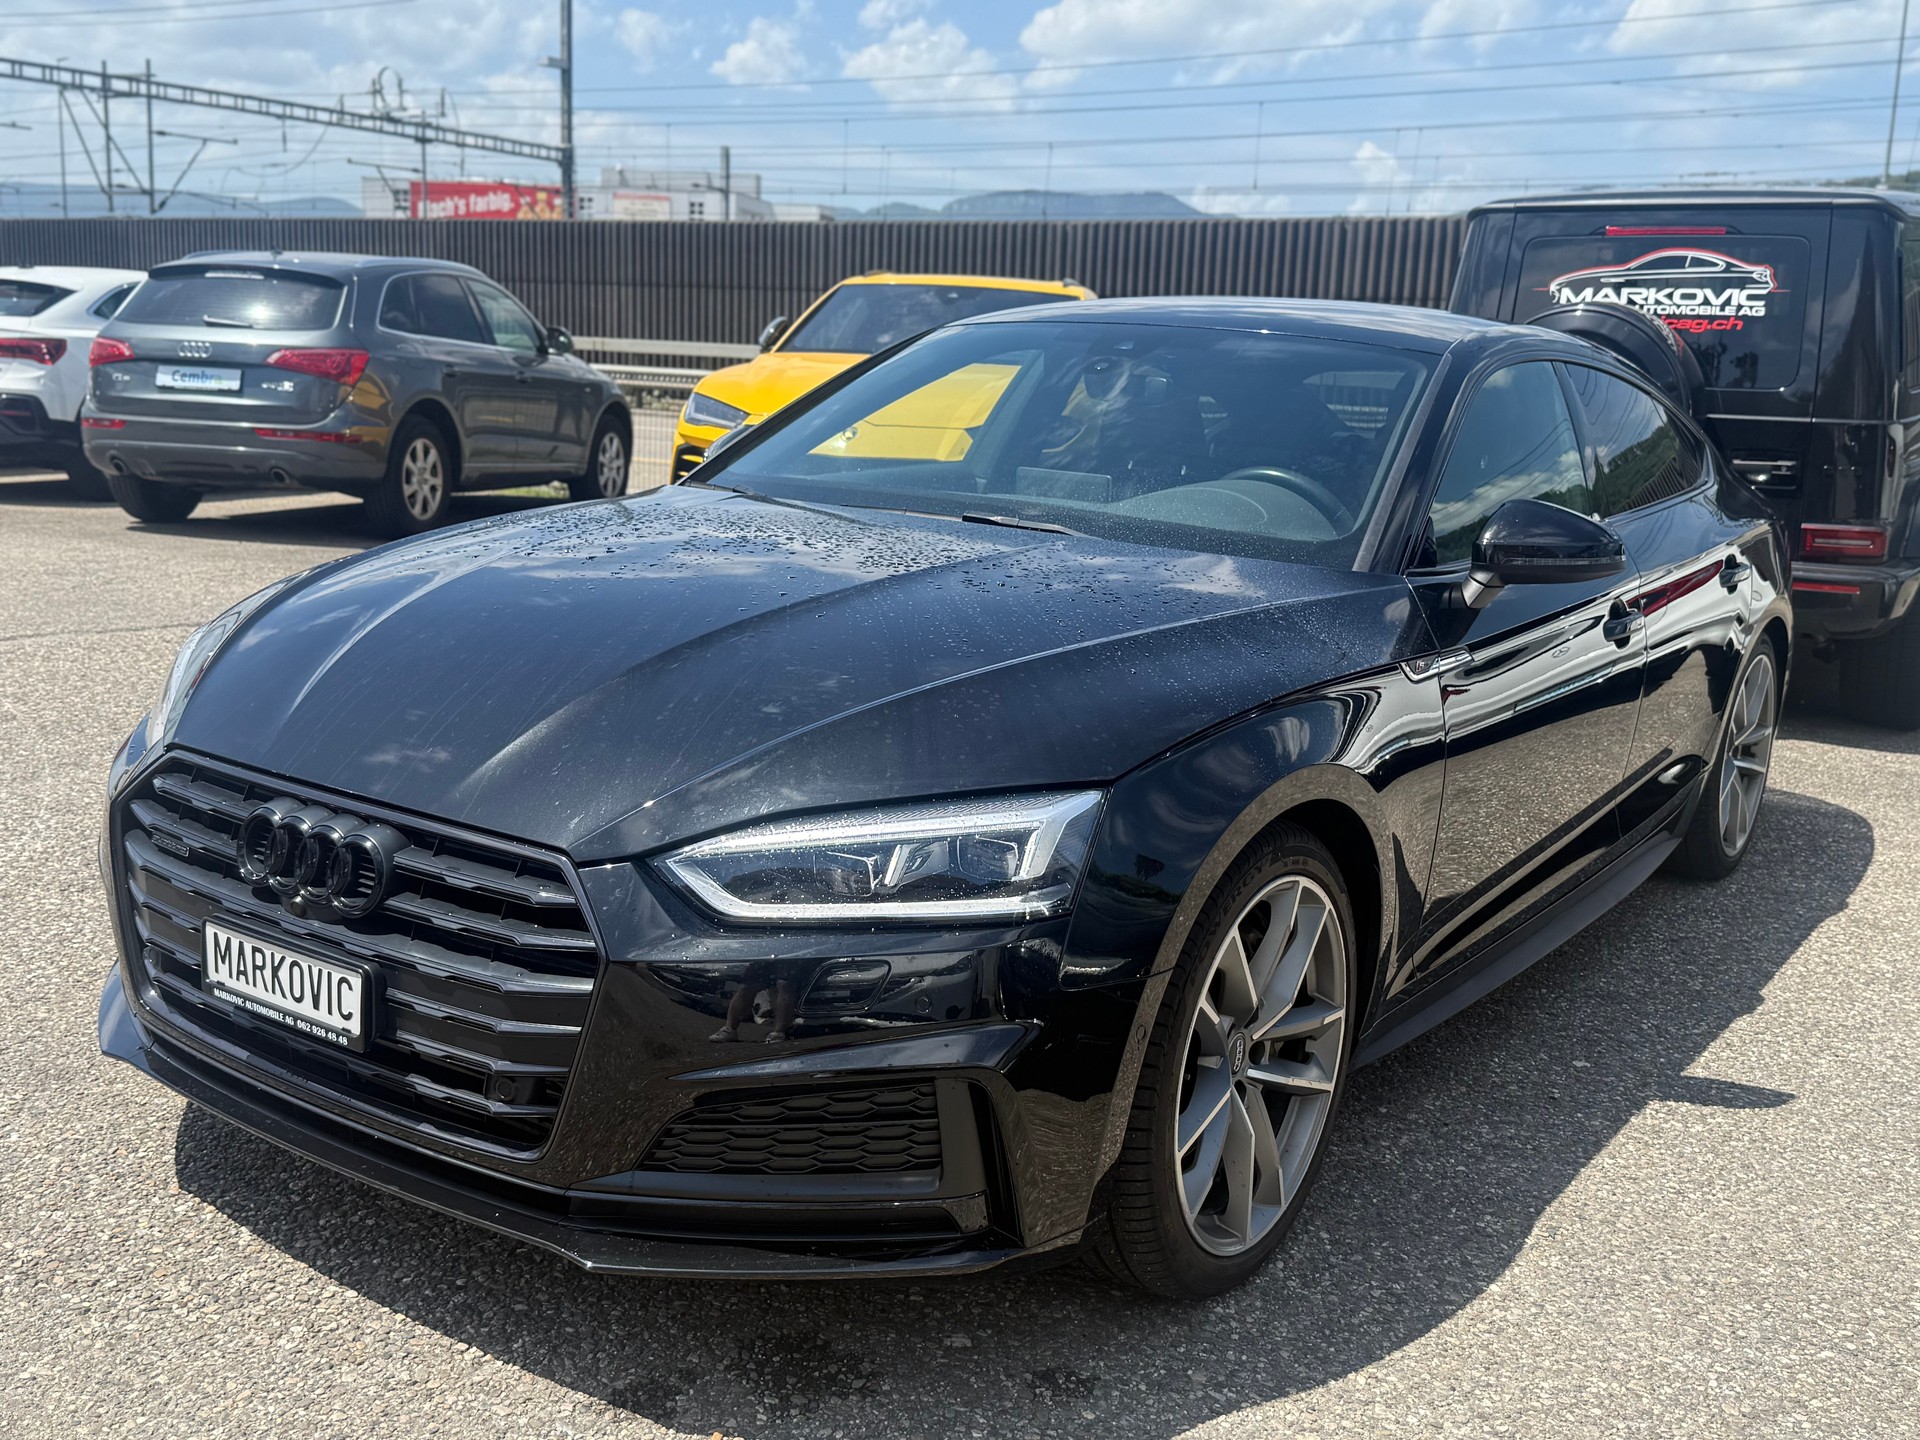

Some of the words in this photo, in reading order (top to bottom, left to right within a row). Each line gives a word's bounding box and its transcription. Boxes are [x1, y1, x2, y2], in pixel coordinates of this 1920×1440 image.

[469, 190, 515, 213] farbig.
[1559, 287, 1768, 306] MARKOVIC
[1737, 306, 1766, 317] AG
[171, 369, 222, 385] Cembra
[213, 931, 354, 1022] MARKOVIC
[213, 987, 245, 1007] MARKOVIC
[245, 1000, 285, 1022] AUTOMOBILE
[285, 1015, 295, 1026] AG
[297, 1019, 311, 1032] 062
[312, 1025, 326, 1038] 926
[327, 1031, 337, 1042] 48
[338, 1035, 348, 1046] 48
